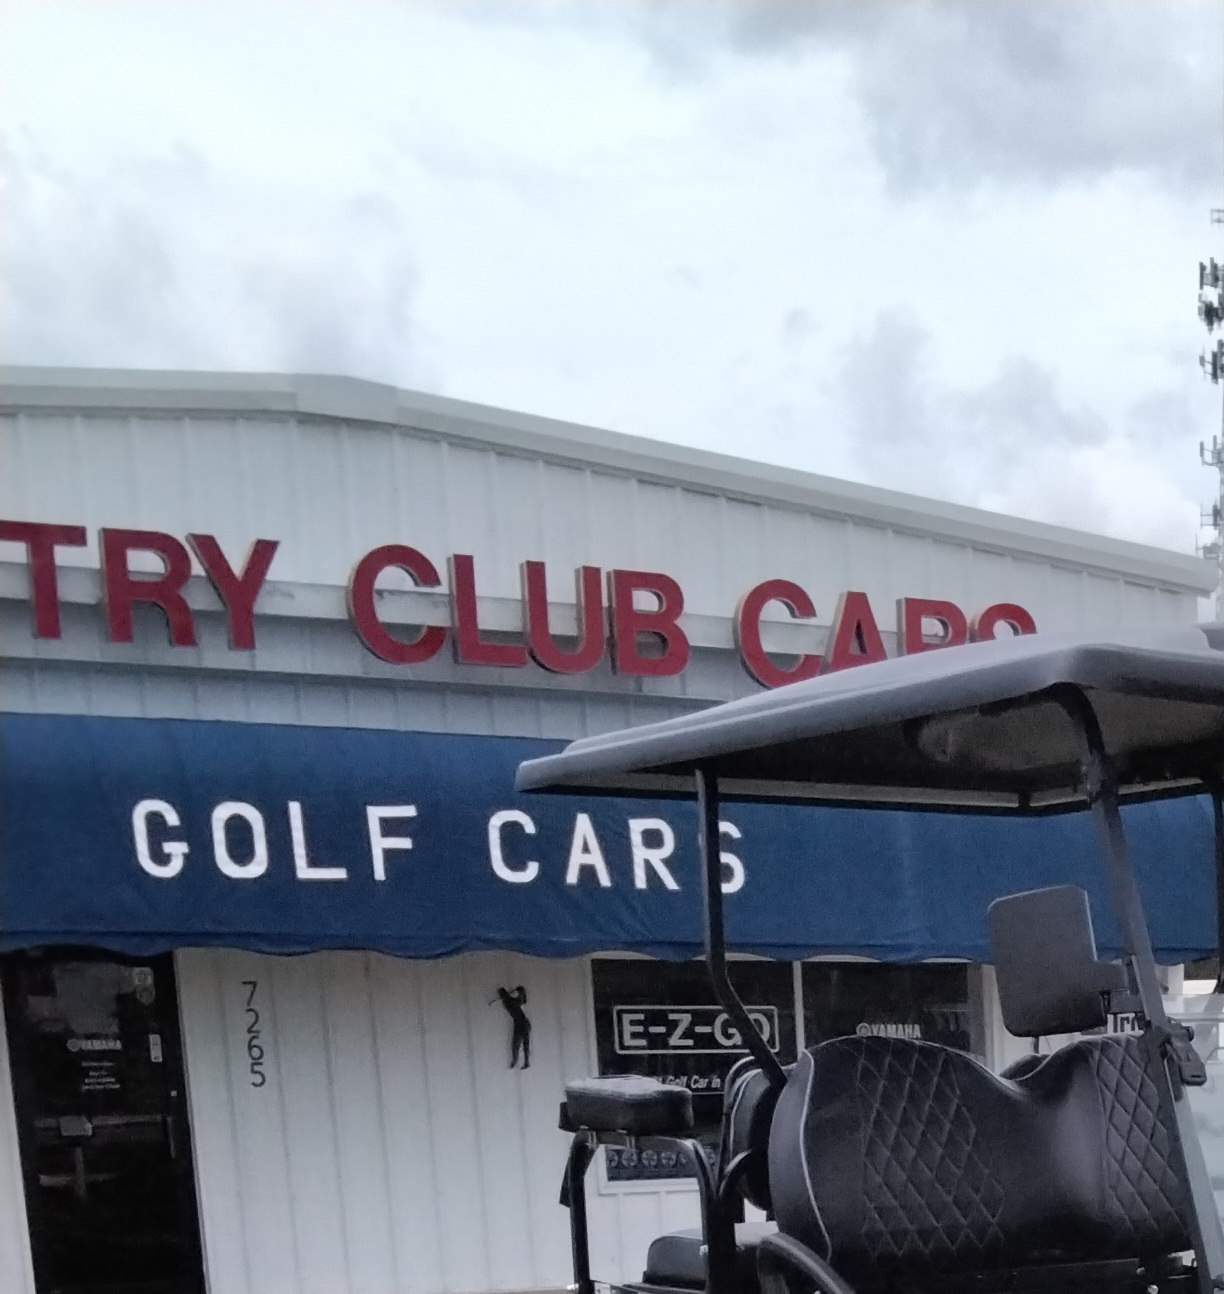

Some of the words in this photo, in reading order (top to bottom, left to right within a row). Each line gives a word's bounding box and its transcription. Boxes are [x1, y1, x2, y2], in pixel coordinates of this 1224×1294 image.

[347, 543, 691, 676] CLUB
[131, 799, 418, 882] GOLF
[487, 809, 747, 895] CARS
[241, 980, 266, 1088] 7265
[621, 1012, 771, 1047] E-Z-GO
[871, 1023, 921, 1039] YAMAHA
[690, 1075, 709, 1089] Car
